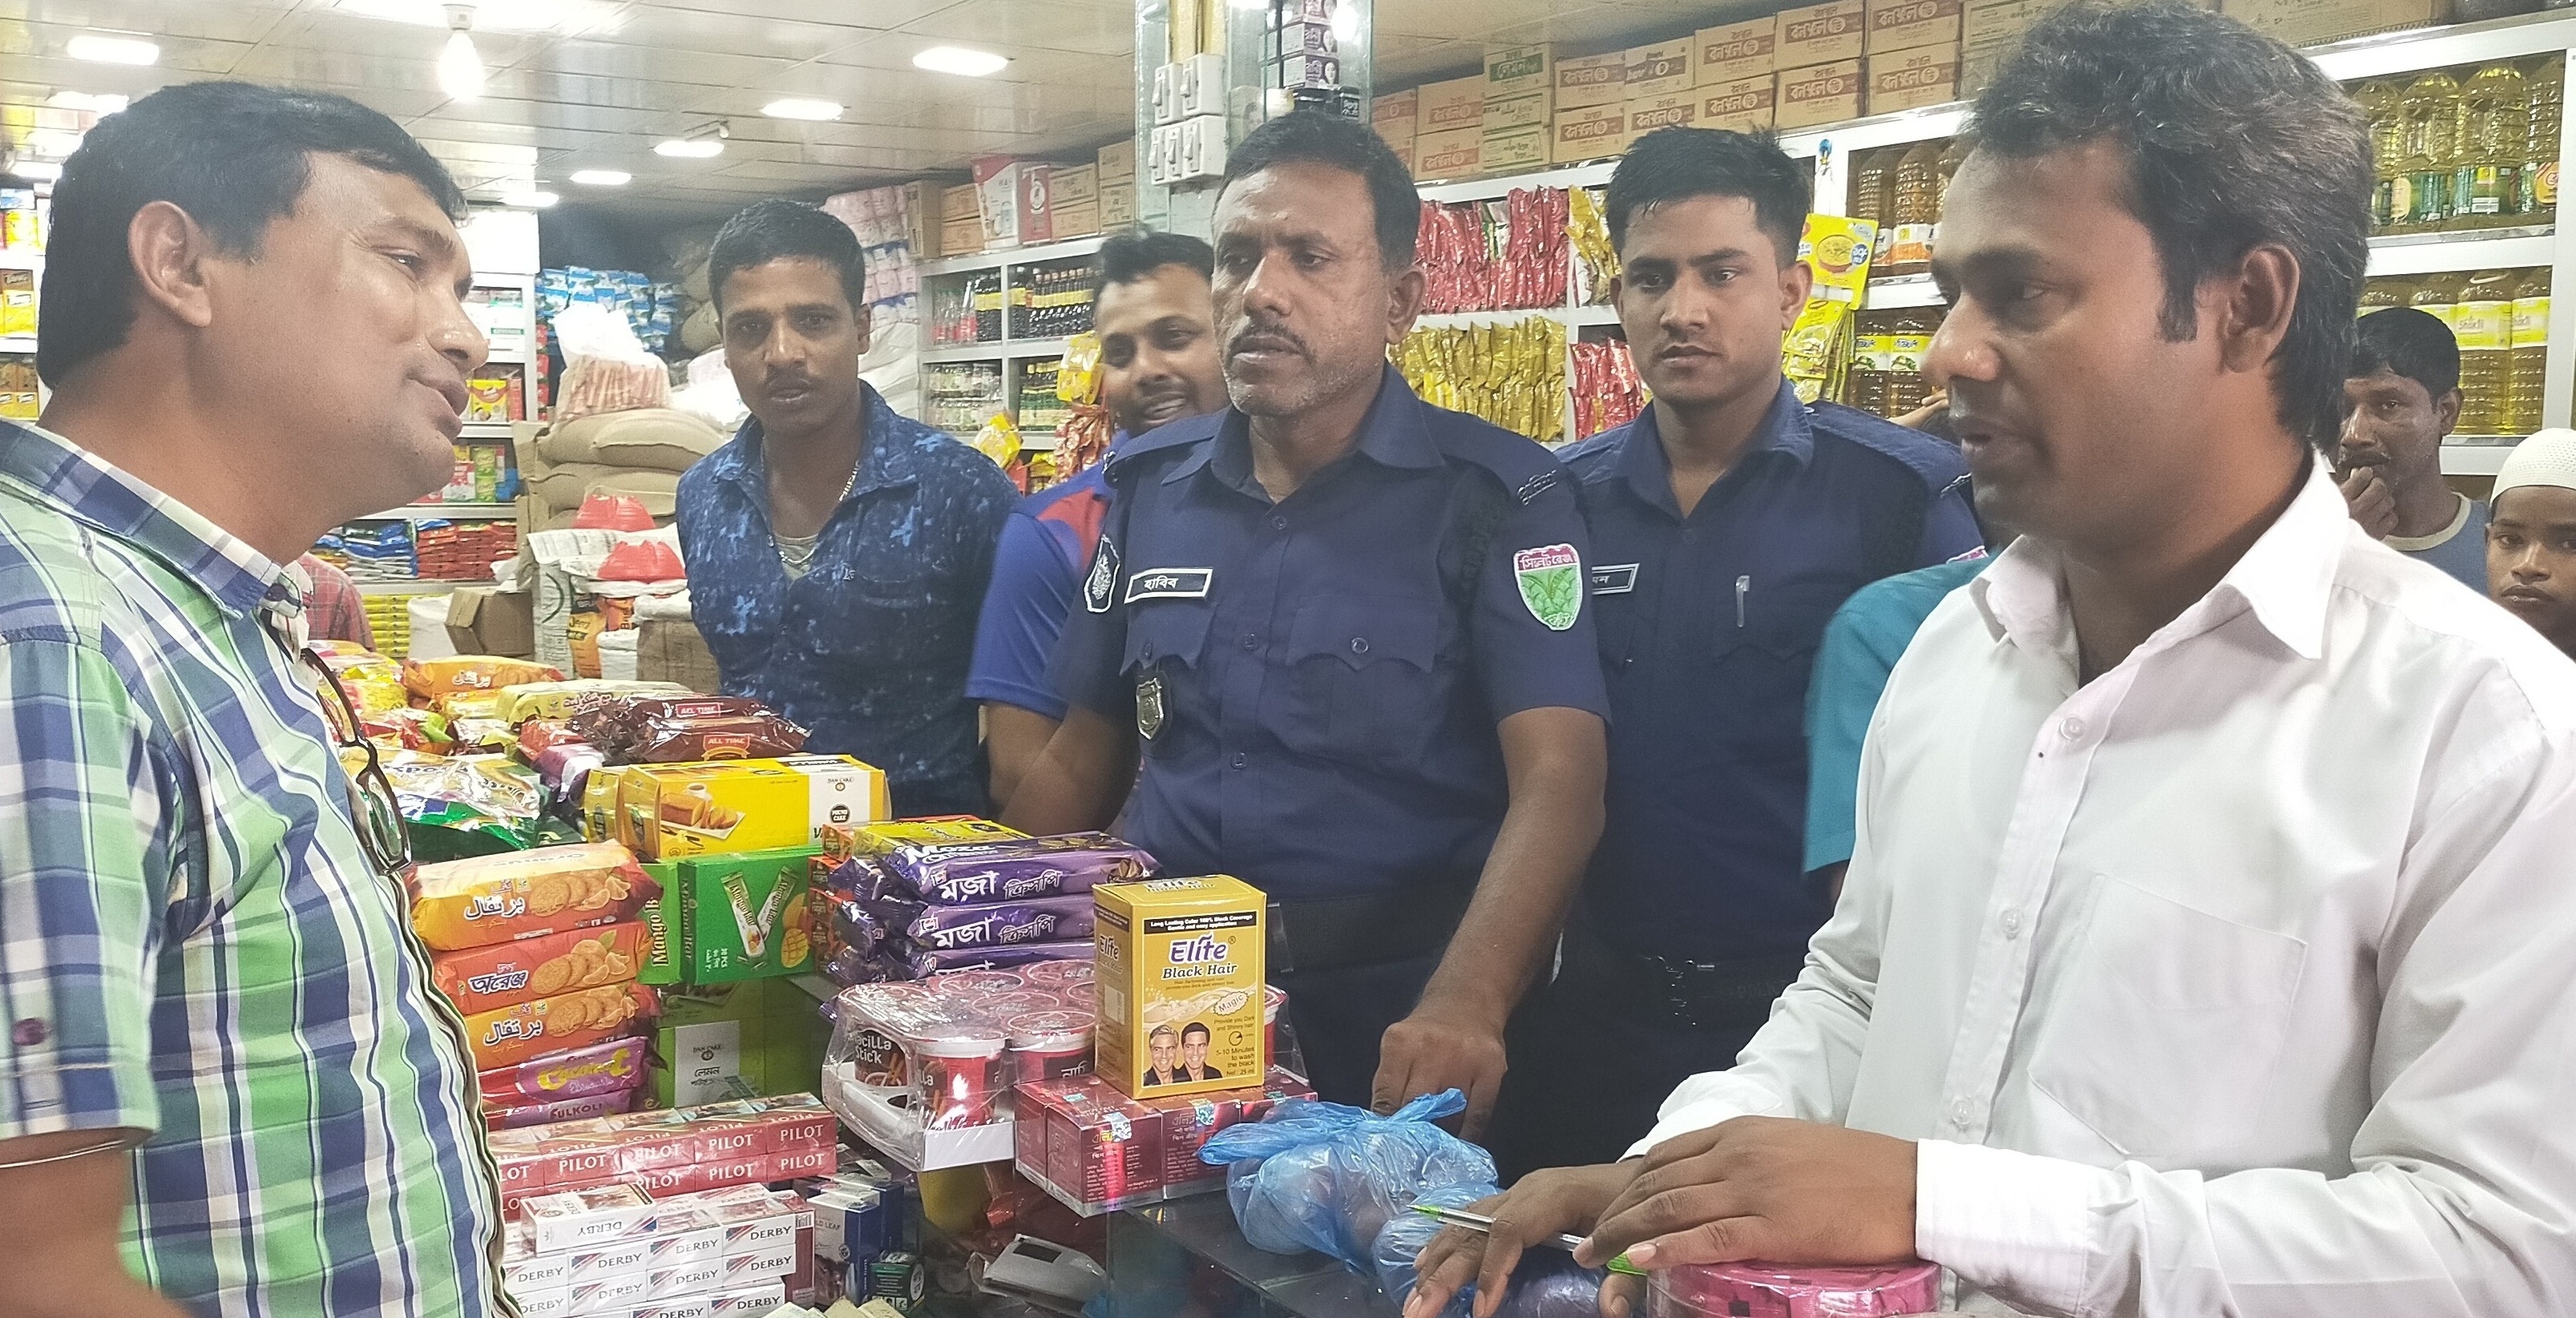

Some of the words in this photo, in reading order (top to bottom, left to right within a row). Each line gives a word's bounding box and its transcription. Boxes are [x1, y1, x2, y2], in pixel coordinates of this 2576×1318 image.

[1143, 575, 1178, 590] হাবিব
[650, 913, 669, 966] Mango
[1170, 933, 1227, 962] Elite
[1162, 965, 1202, 979] Black
[1207, 963, 1238, 975] Hair
[1218, 994, 1244, 1013] Magic
[855, 1046, 882, 1064] Stick
[780, 1124, 824, 1142] PILOT
[709, 1134, 754, 1151] PILOT
[559, 1155, 606, 1173] PILOT
[781, 1153, 825, 1171] PILOT
[499, 1165, 531, 1182] LOT
[709, 1163, 755, 1181] PILOT
[577, 1221, 623, 1236] DERBY
[750, 1225, 792, 1240] DERBY
[676, 1239, 719, 1254] DERBY
[598, 1253, 643, 1268] DERBY
[751, 1256, 792, 1271] DERBY
[519, 1267, 563, 1283] DERBY
[676, 1269, 719, 1285] DERBY
[599, 1283, 643, 1300] DERBY
[737, 1296, 781, 1310] DERBY
